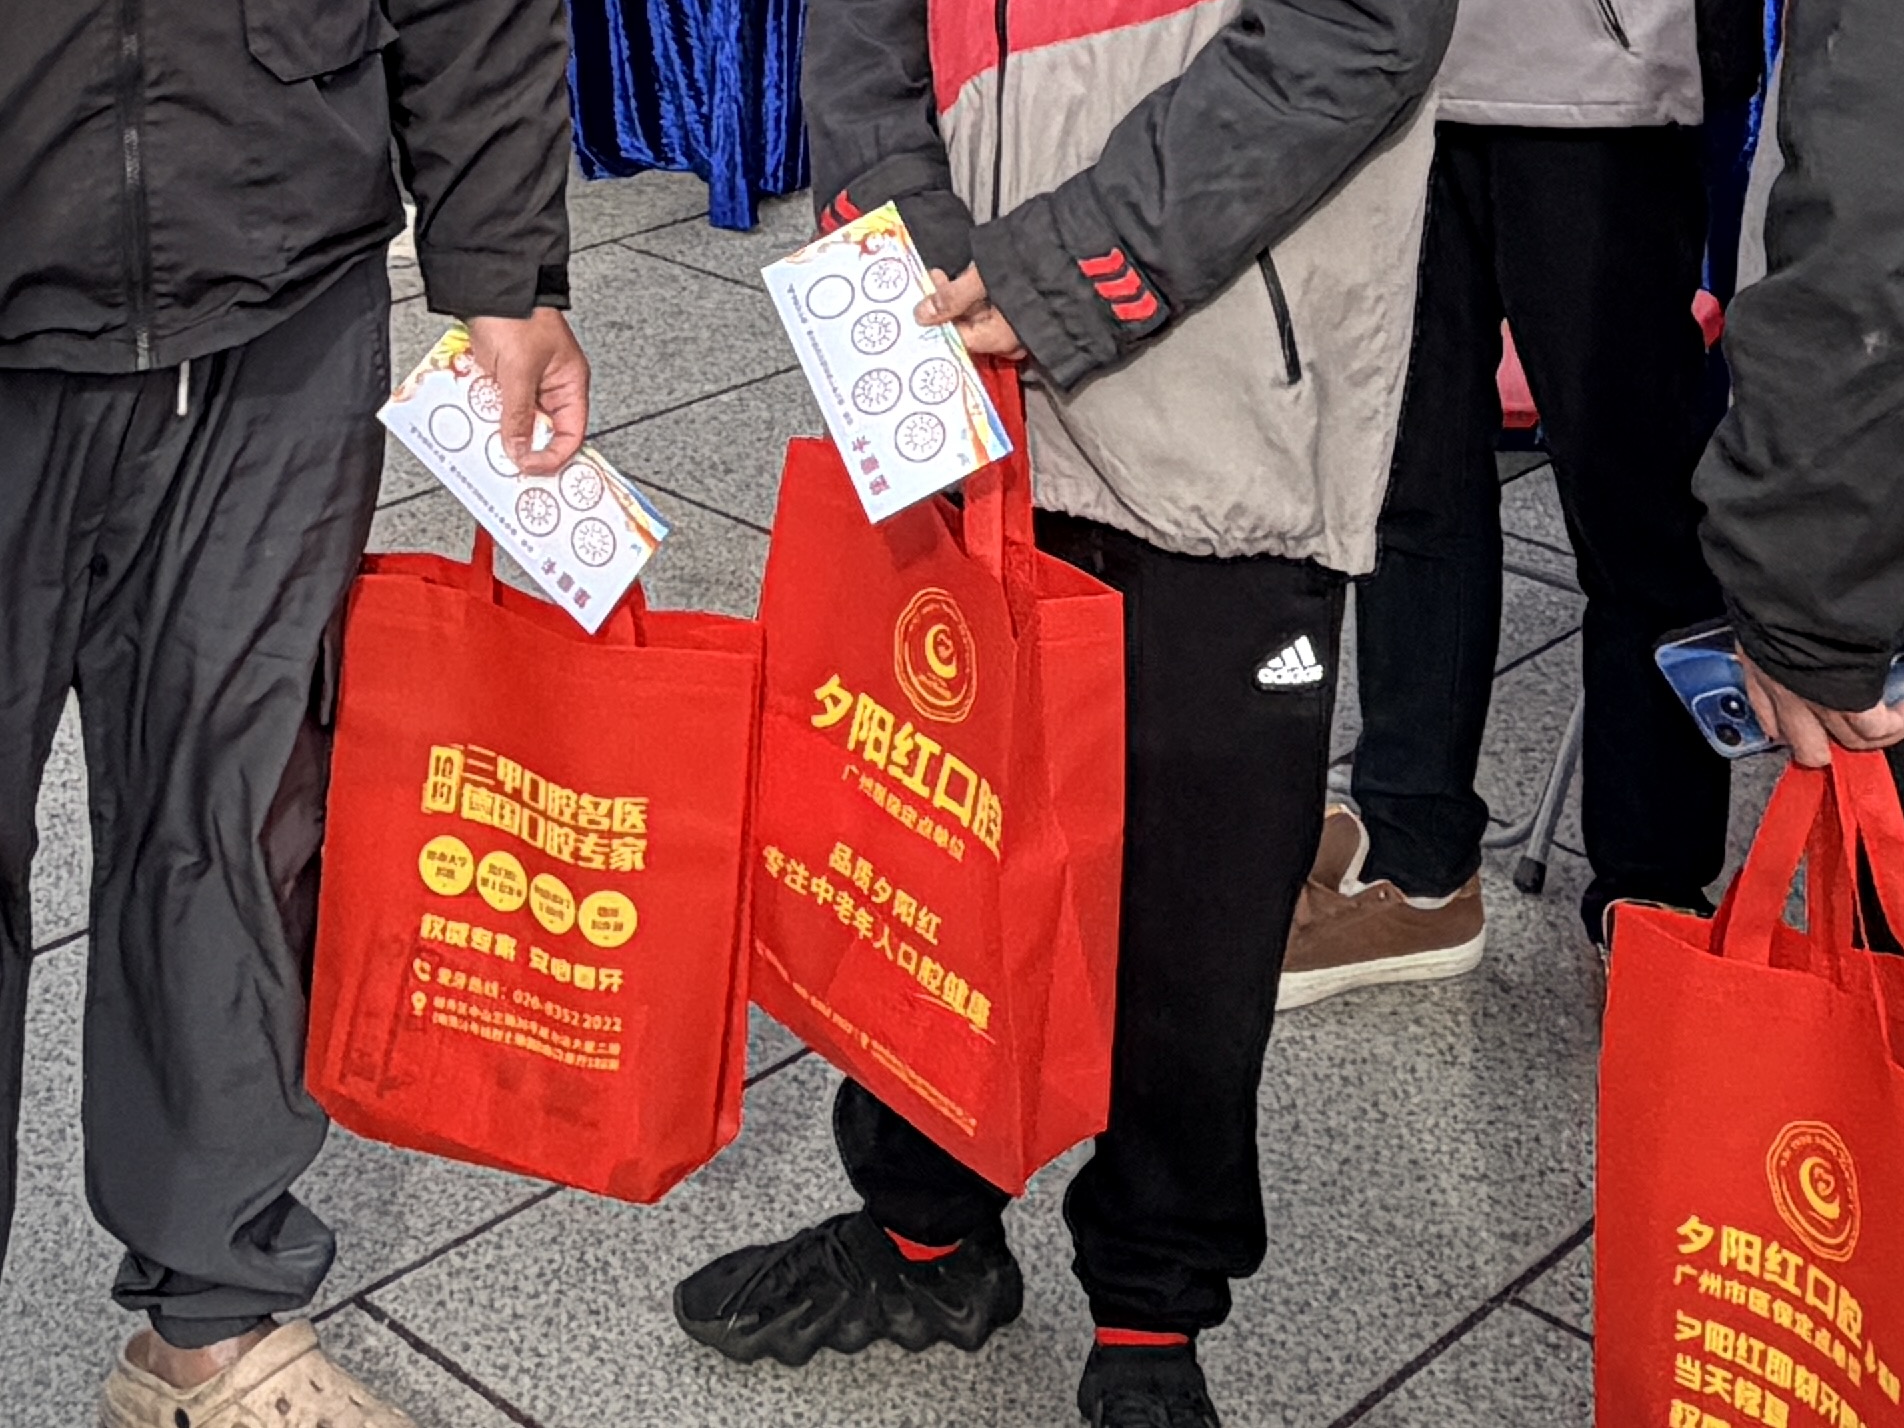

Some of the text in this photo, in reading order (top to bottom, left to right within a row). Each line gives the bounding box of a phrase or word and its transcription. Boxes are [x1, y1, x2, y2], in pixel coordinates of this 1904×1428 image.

[460, 781, 647, 872] 德国口腔专家
[462, 743, 650, 834] 三甲口腔名医
[810, 672, 1003, 863] 夕阳红口腔
[762, 845, 992, 1030] 专注中老年人口腔健康
[829, 841, 942, 946] 品质夕阳红
[1676, 1214, 1863, 1350] 夕阳红口腔
